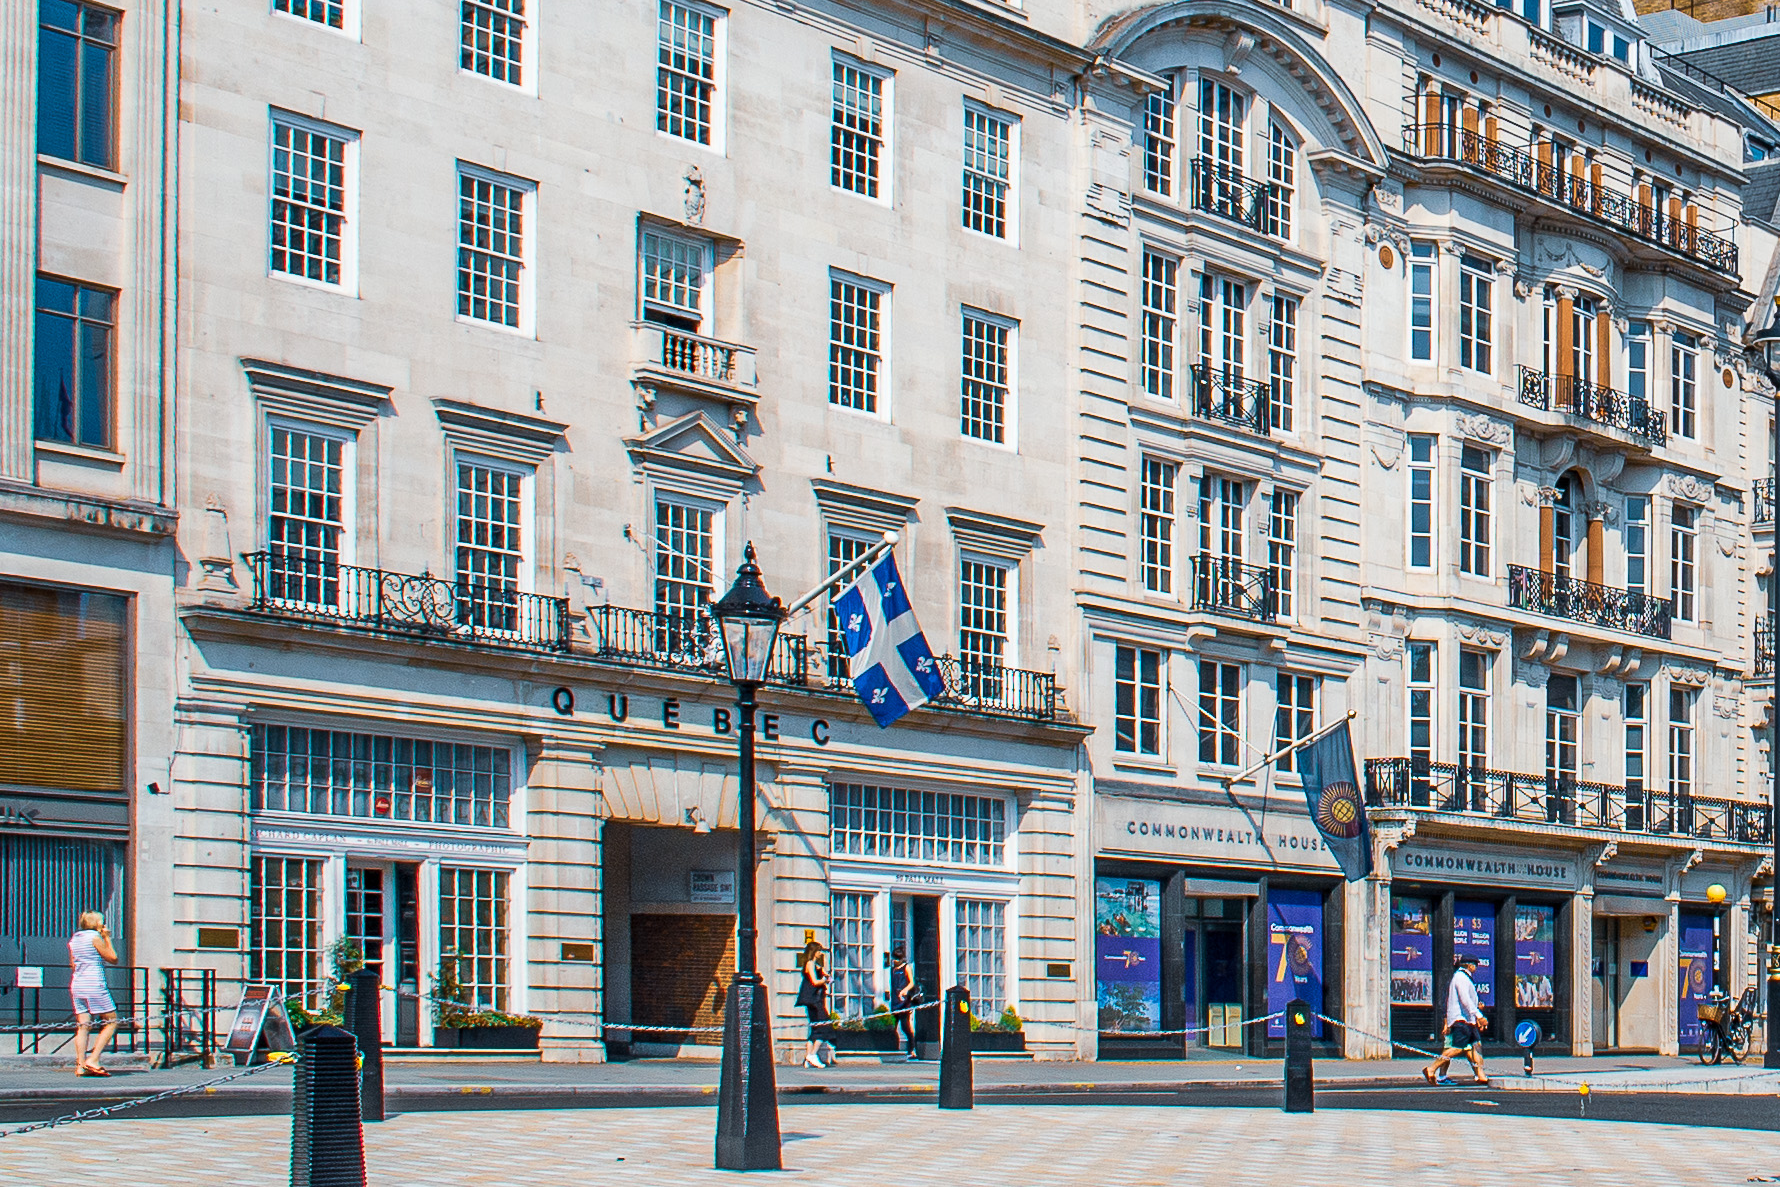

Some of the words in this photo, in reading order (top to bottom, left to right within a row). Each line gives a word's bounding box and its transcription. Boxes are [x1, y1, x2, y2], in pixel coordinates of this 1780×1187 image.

[552, 686, 830, 746] QUÉBEC
[1127, 820, 1263, 845] COMMONWEALTH
[1278, 834, 1327, 851] HOUSE
[1404, 853, 1516, 874] COMMONWEALTH
[1526, 865, 1566, 879] HOUSE
